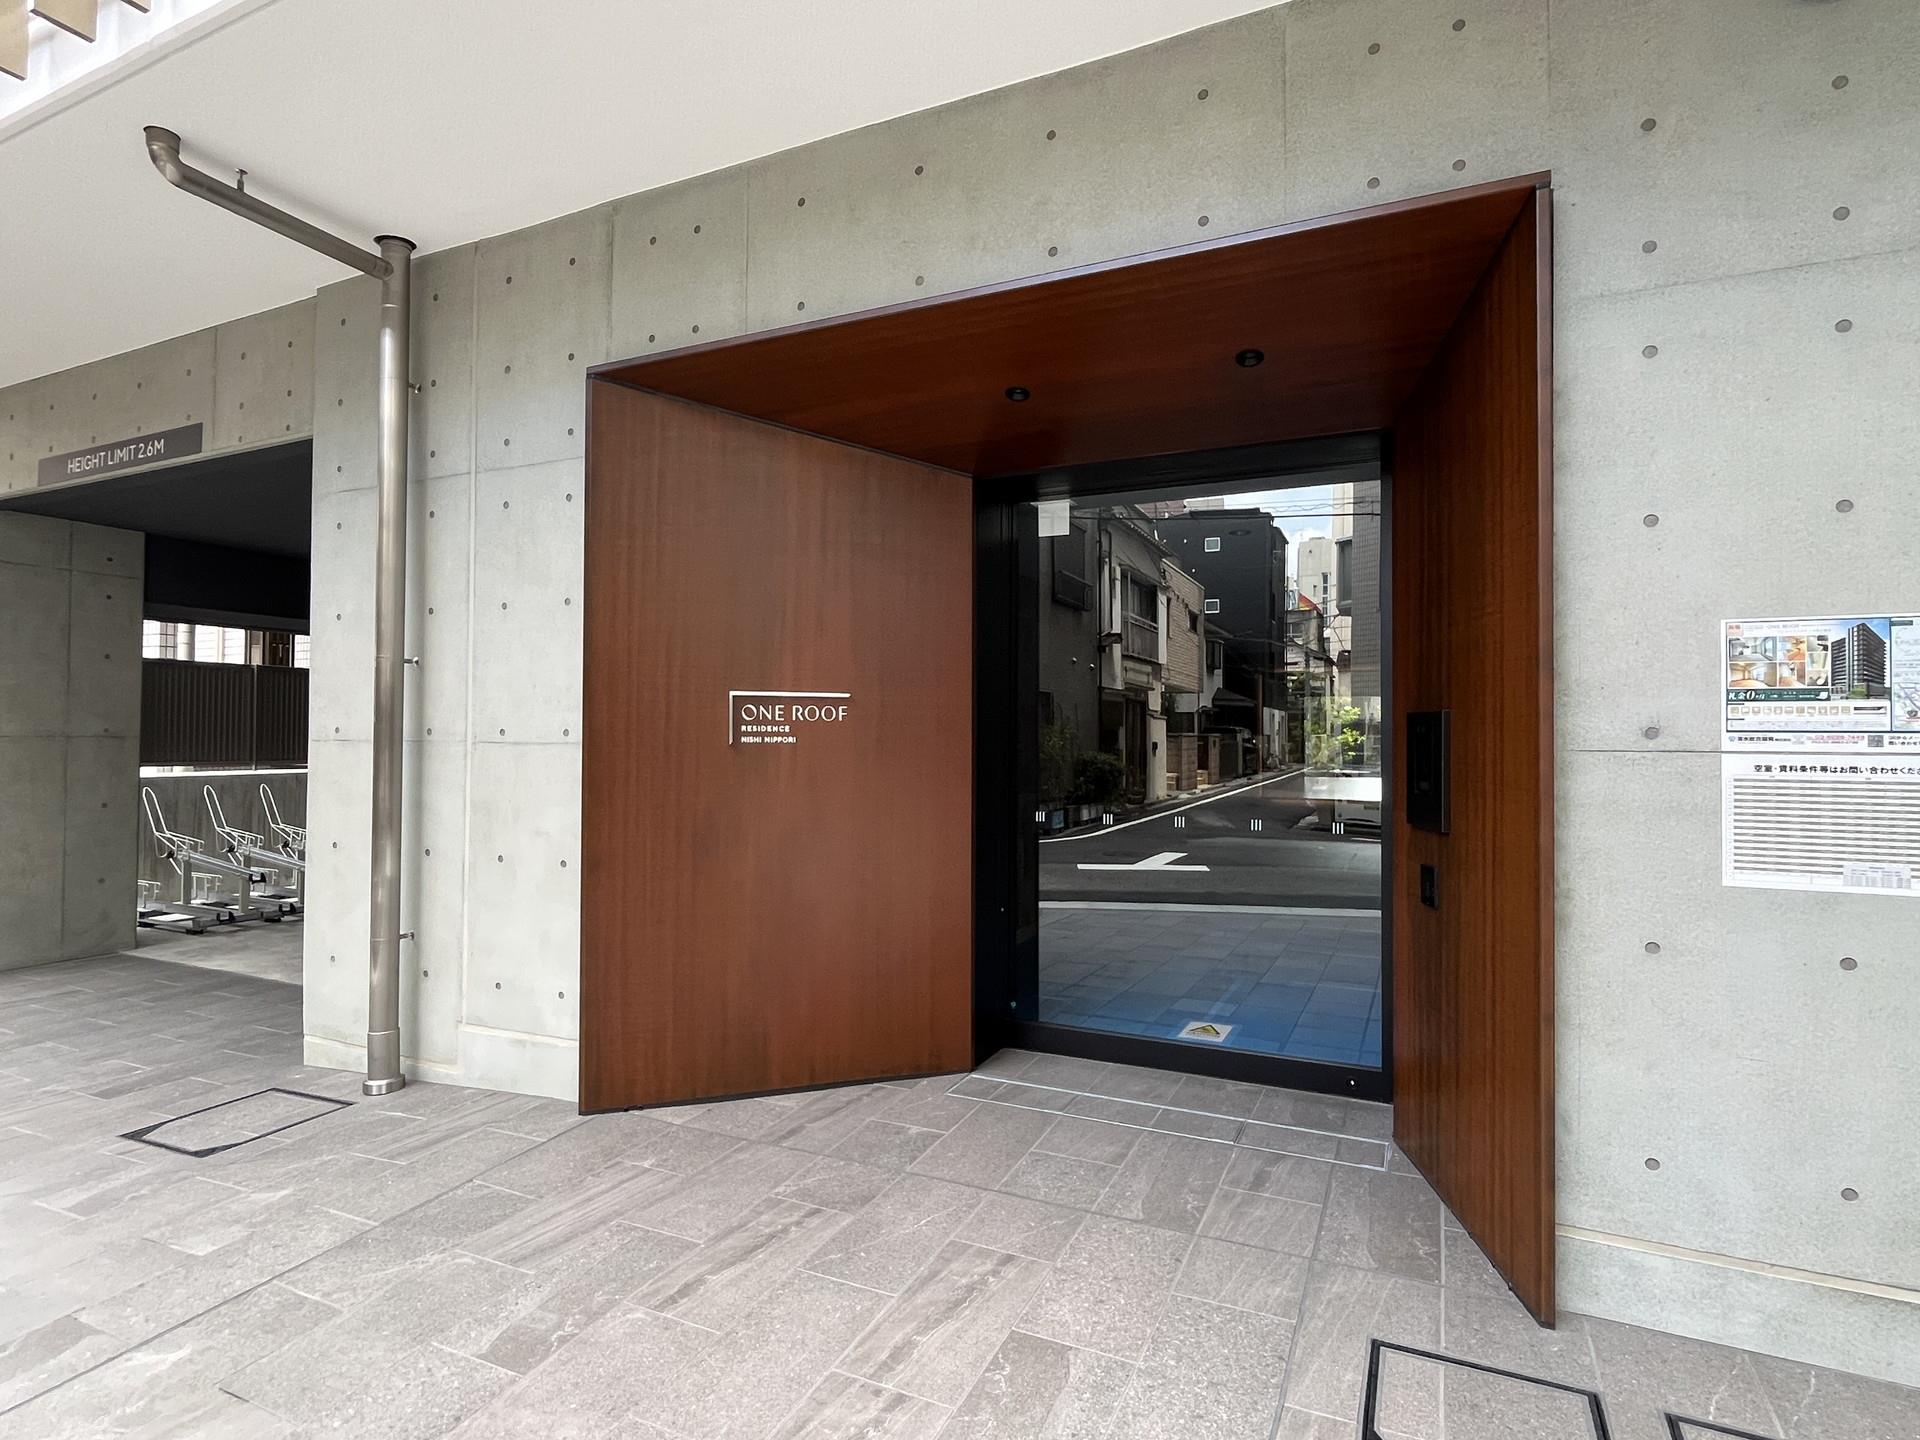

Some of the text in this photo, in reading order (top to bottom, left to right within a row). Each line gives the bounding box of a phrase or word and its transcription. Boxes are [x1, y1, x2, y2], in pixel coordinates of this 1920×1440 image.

[67, 439, 165, 473] HEIGHT LIMIT 2.6M
[741, 704, 848, 722] ONE ROOF
[741, 725, 791, 733] RESIDENCE
[741, 736, 797, 744] NISHI NIPPORI
